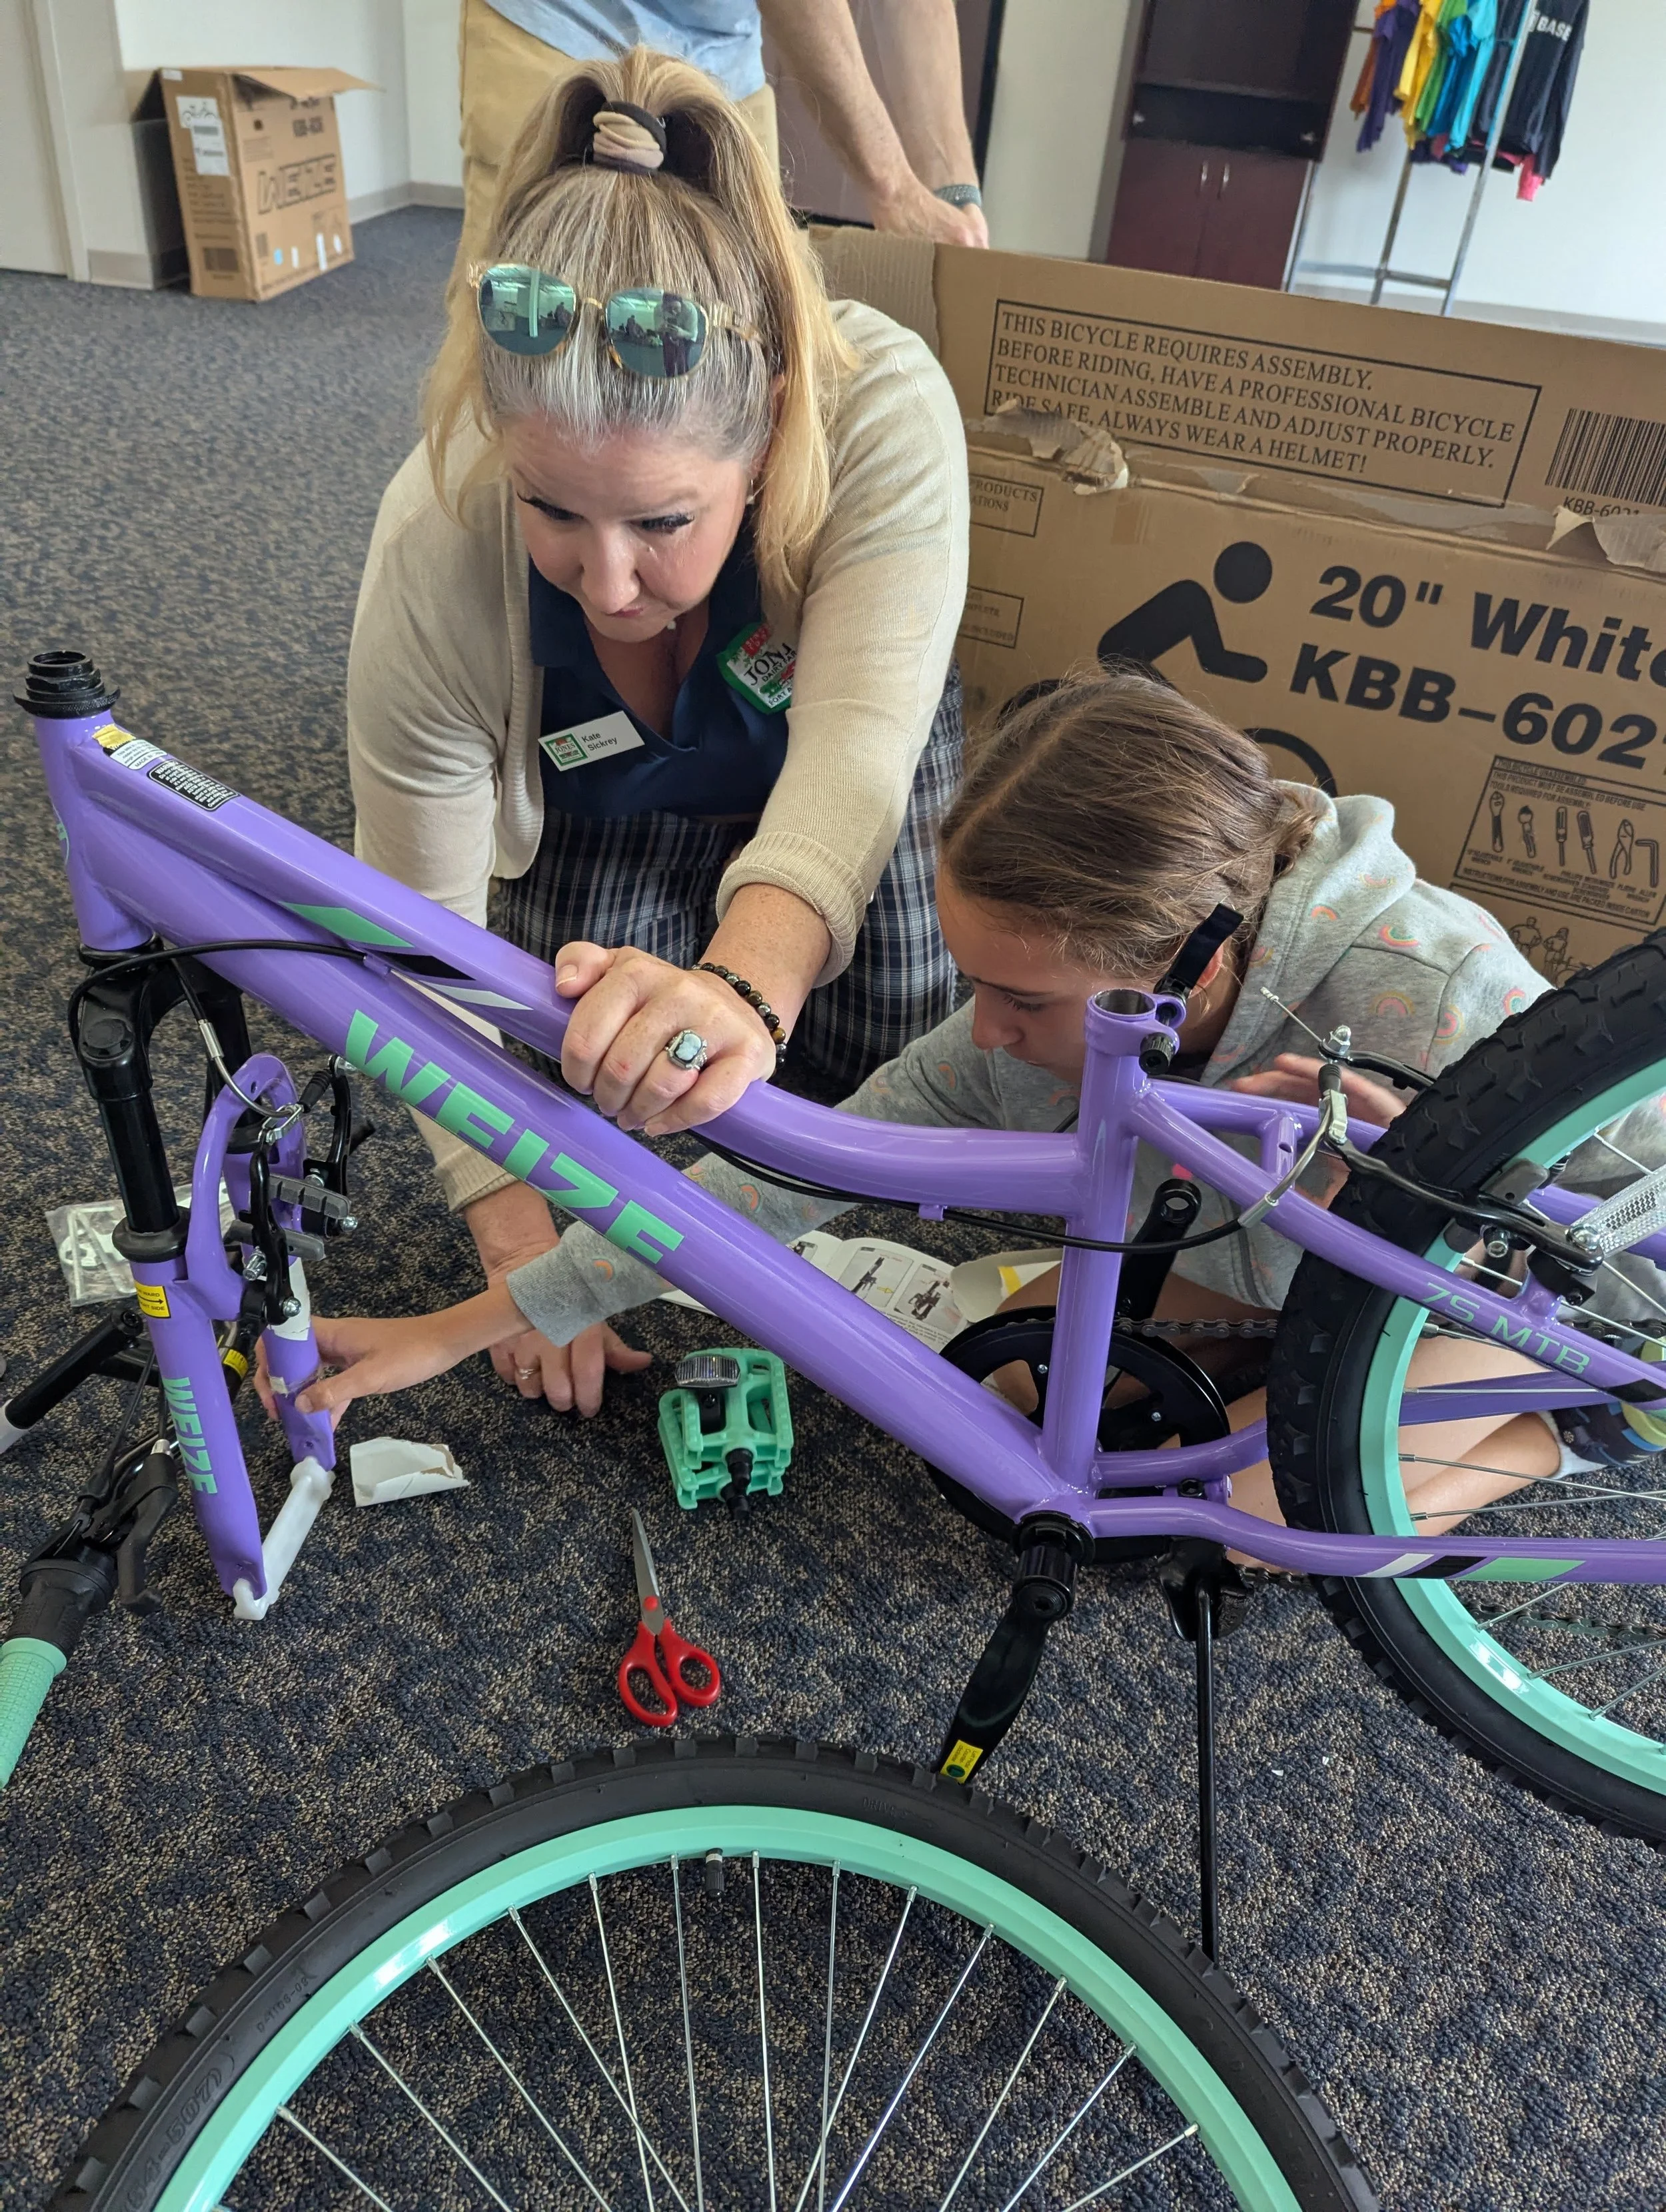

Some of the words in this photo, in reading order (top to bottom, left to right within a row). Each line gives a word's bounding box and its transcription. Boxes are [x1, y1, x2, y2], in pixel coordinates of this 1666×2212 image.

[1002, 311, 1045, 336] THIS
[1050, 320, 1139, 352] BICYCLE
[1143, 335, 1249, 370] REQUIRES
[1250, 352, 1372, 390] ASSEMBLY.
[994, 363, 1117, 400] TECHNICIAN
[1121, 390, 1231, 422] ASSEMBLE
[1234, 406, 1281, 430] AND
[1283, 417, 1370, 446] ADJUST
[1373, 430, 1494, 468] PROPERLY.
[997, 338, 1074, 368] BEFORE
[1078, 351, 1155, 384] RIDING,
[1161, 364, 1217, 392] HAVE
[1220, 376, 1234, 395] A
[1239, 379, 1406, 424] PROFESSIONAL
[1409, 407, 1515, 442] BICYCLE
[1042, 398, 1094, 426] SAFE,
[1098, 410, 1180, 440] ALWAYS
[1186, 424, 1245, 452] WEAR
[1250, 436, 1263, 454] A
[1267, 439, 1367, 474] HELMET!
[1309, 565, 1443, 628] 20"
[762, 664, 782, 682] DAIRY
[768, 692, 786, 706] FORT
[1289, 642, 1666, 776] KBB-602
[554, 742, 576, 754] JONES
[581, 732, 601, 743] Kate
[587, 737, 618, 752] Sickrey
[345, 1009, 685, 1264] WEIZE
[1422, 1282, 1480, 1323] 7S
[1490, 1315, 1591, 1375] MTB
[162, 1377, 218, 1494] WEIZE
